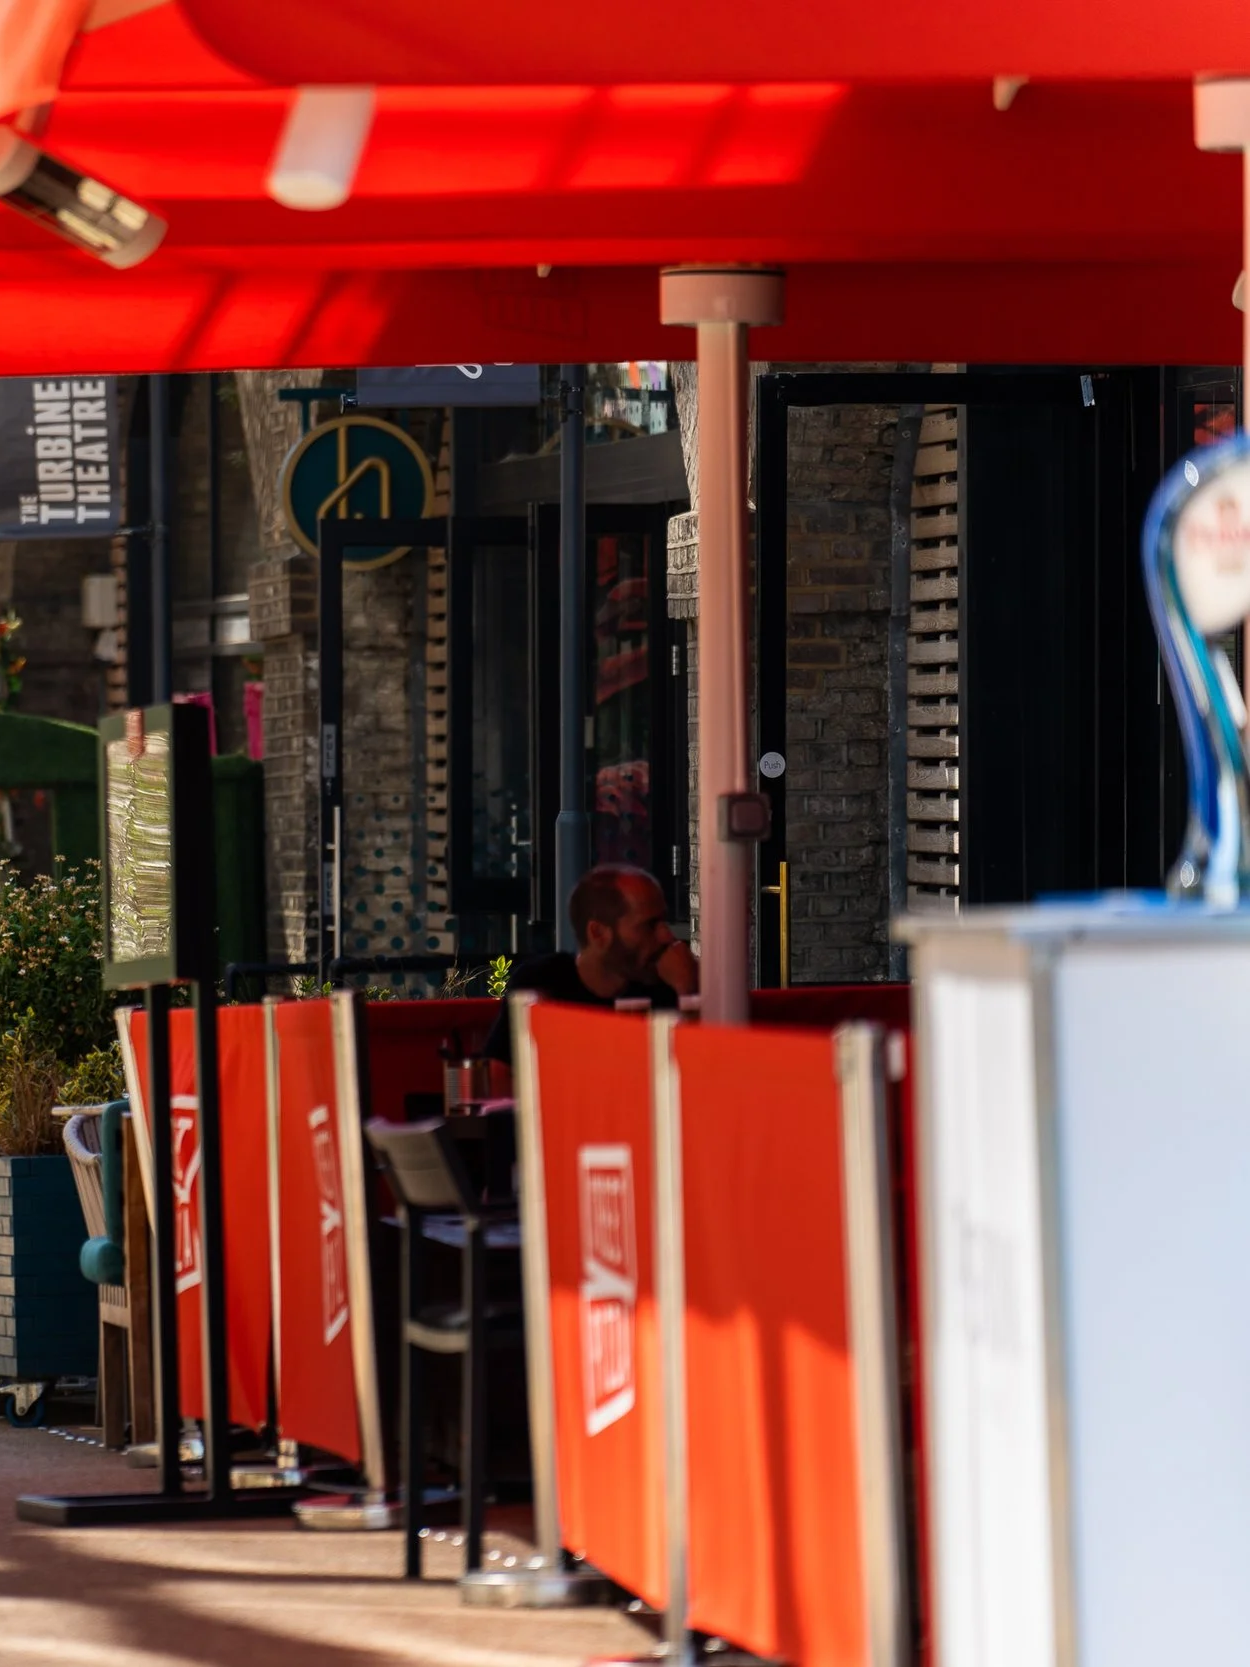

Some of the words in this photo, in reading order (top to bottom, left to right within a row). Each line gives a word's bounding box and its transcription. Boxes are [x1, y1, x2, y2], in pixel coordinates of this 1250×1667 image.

[26, 381, 75, 525] TURBINE
[71, 380, 111, 524] THEATRE
[19, 496, 38, 525] THE
[764, 760, 782, 769] Push
